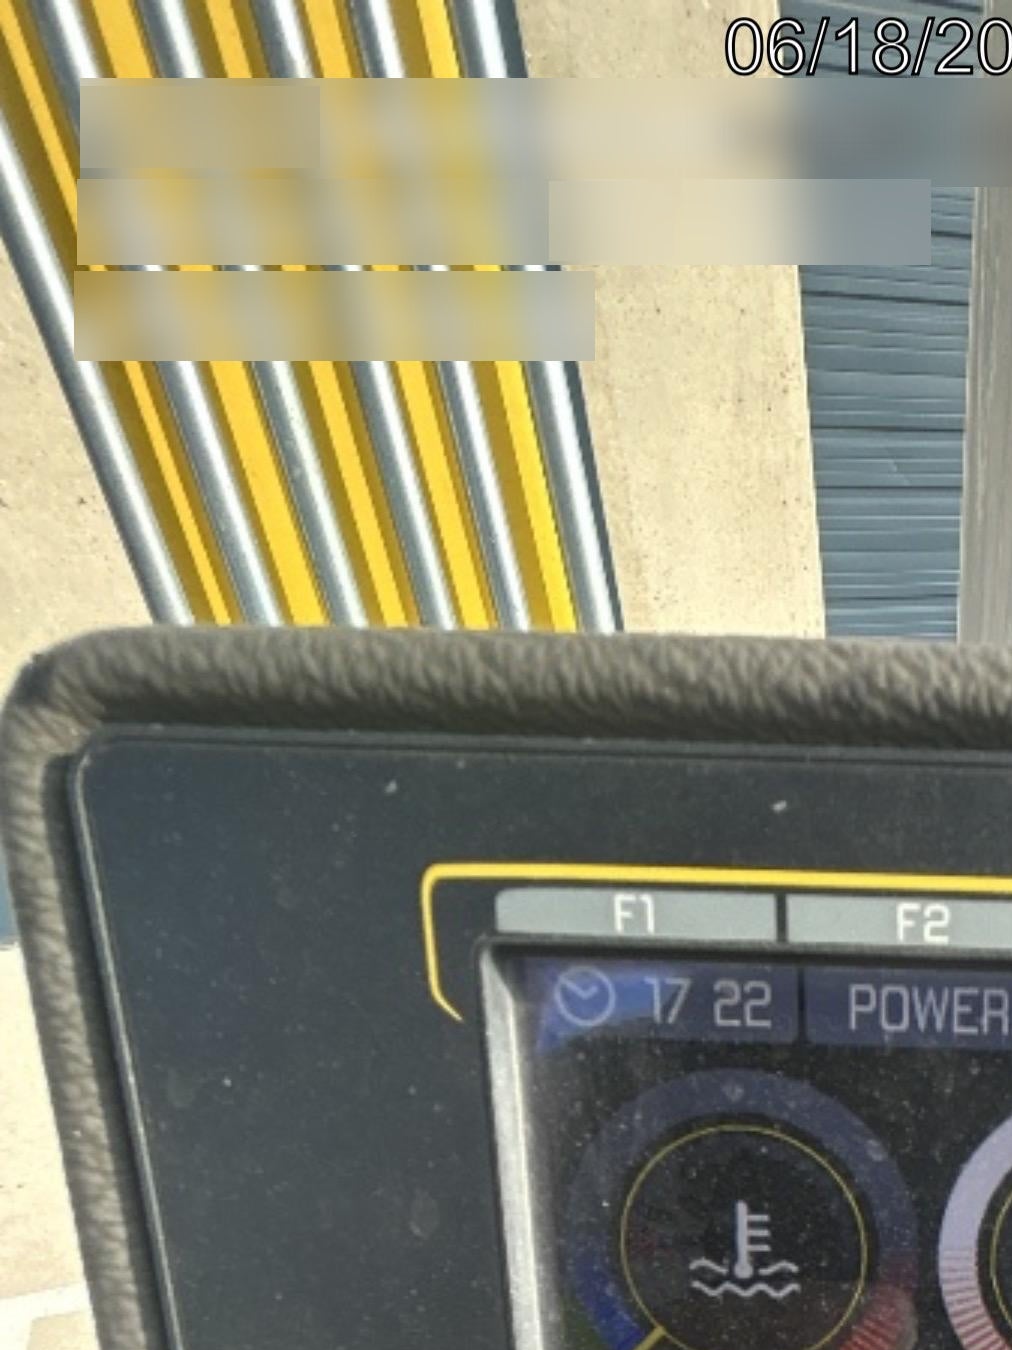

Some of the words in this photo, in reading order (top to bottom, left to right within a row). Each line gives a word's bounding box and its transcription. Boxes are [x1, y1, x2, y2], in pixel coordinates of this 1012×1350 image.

[613, 895, 657, 936] F1
[896, 902, 950, 943] F2
[712, 980, 773, 1029] 22
[847, 984, 1011, 1037] POWER
